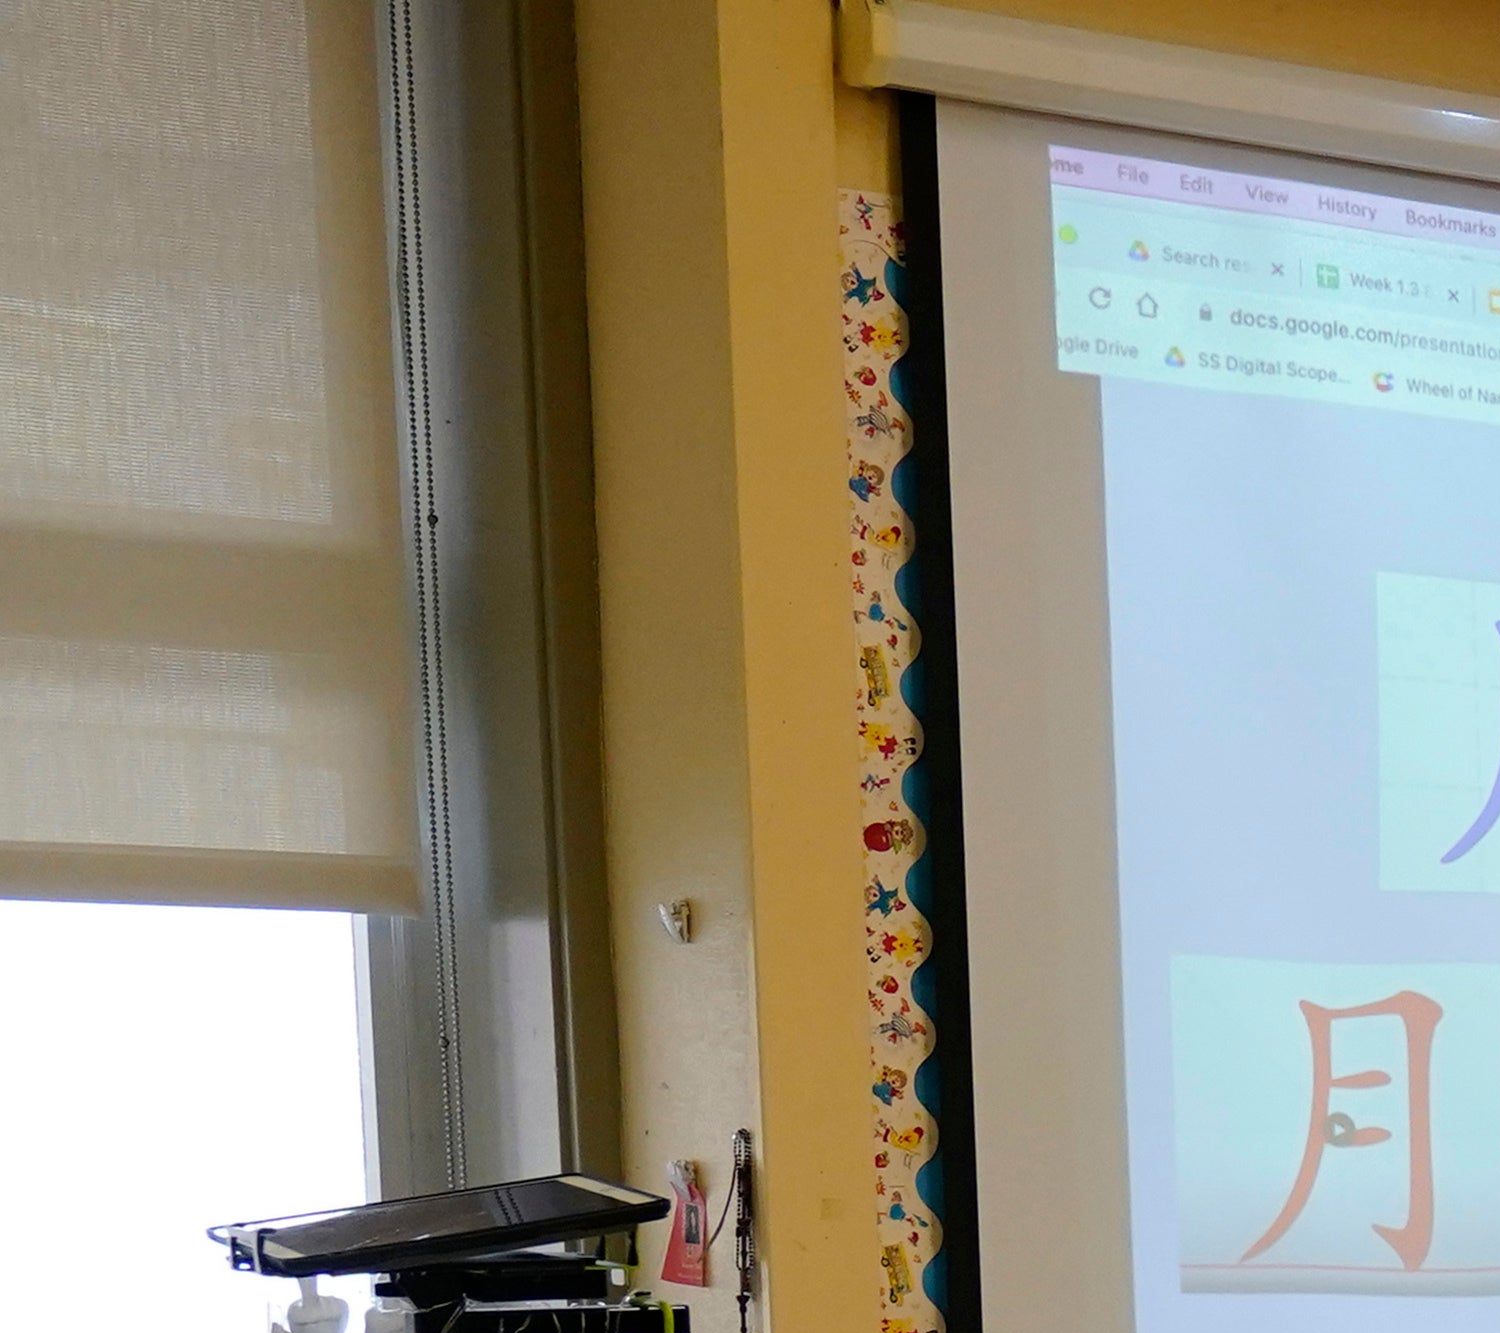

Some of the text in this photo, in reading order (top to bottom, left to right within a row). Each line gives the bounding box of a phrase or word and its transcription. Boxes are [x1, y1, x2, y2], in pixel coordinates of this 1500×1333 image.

[1117, 163, 1149, 184] File
[1180, 174, 1213, 195] Edit
[1245, 184, 1289, 205] View
[1318, 195, 1378, 222] History
[1406, 209, 1496, 239] Bookmarks
[1161, 246, 1219, 269] Search
[1350, 272, 1393, 293] Week
[1095, 338, 1140, 360] Drive
[1198, 352, 1221, 370] SS
[1225, 354, 1281, 378] Digital
[1406, 378, 1454, 400] Wheel
[1458, 384, 1474, 400] of
[1240, 989, 1446, 1275] 月
